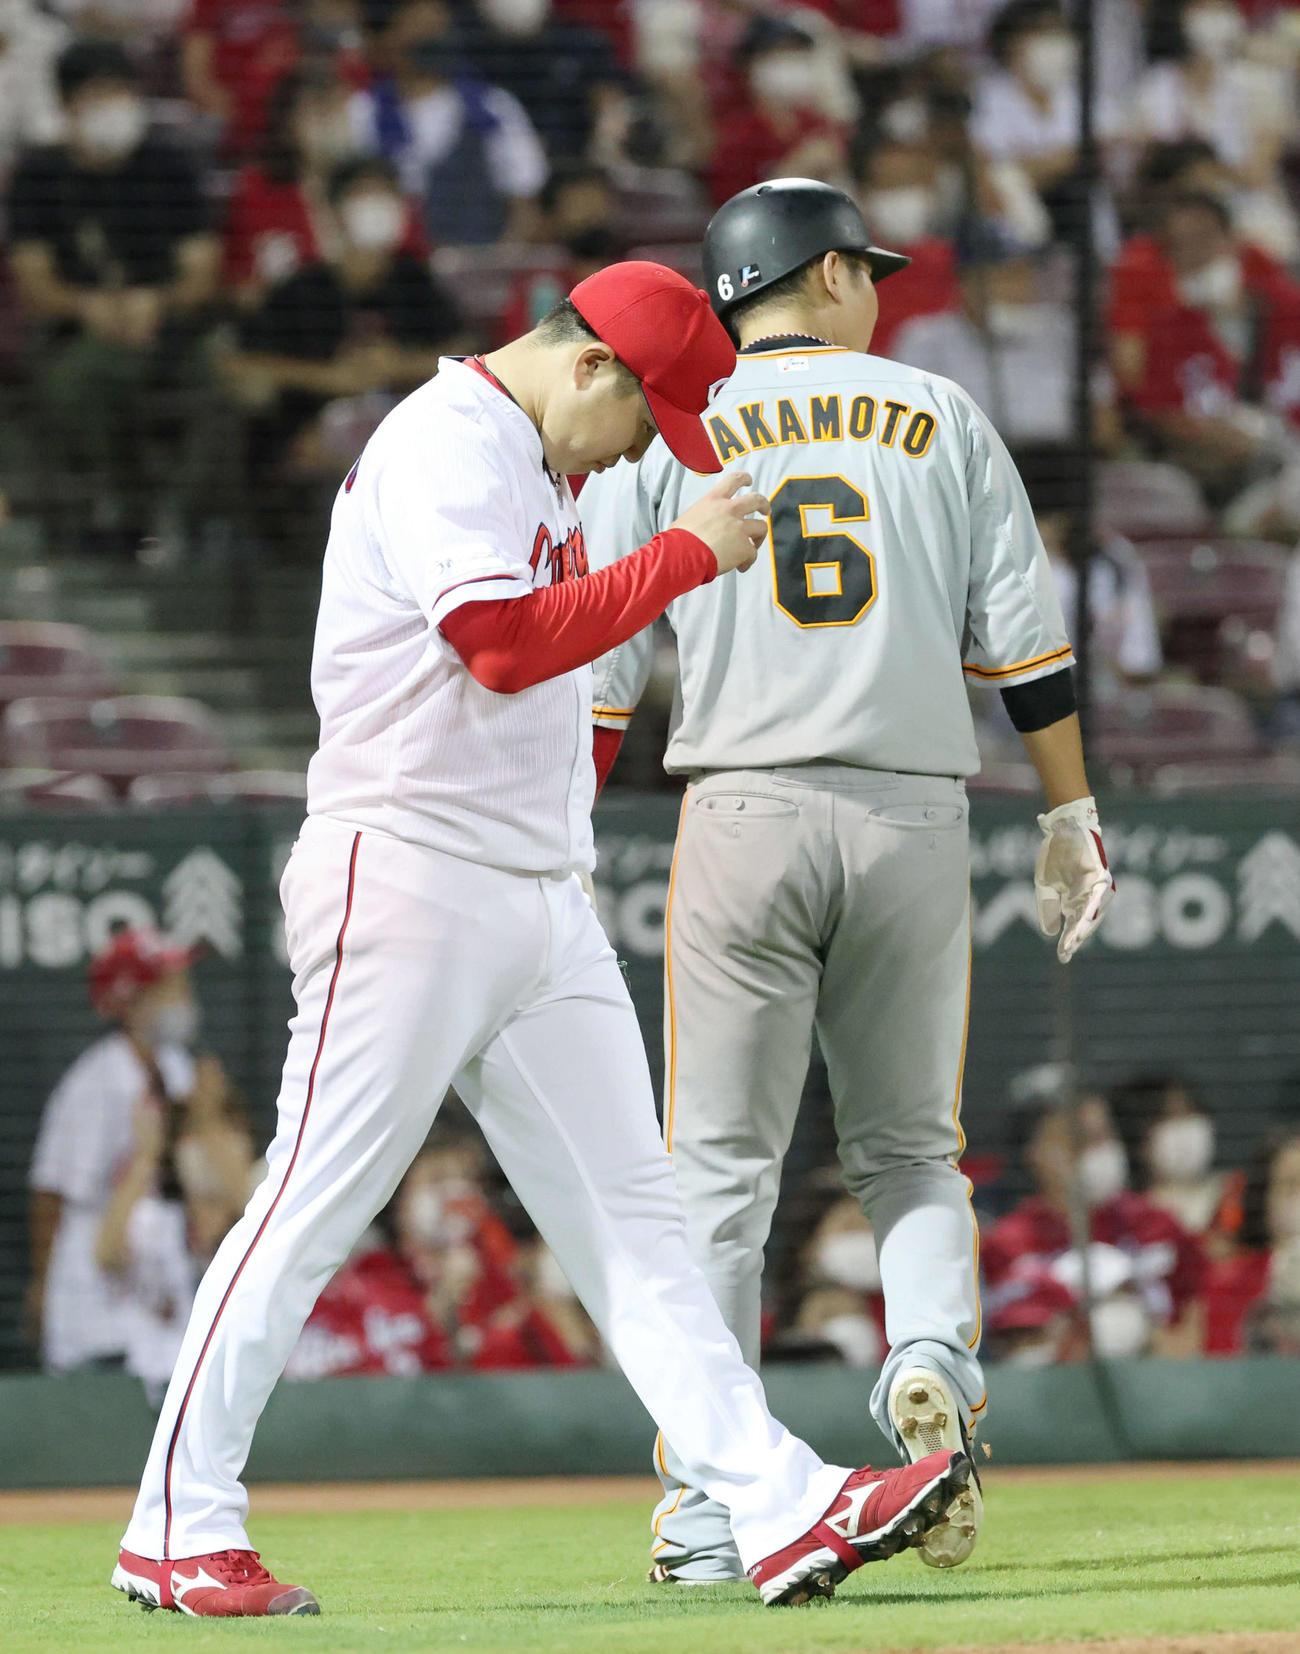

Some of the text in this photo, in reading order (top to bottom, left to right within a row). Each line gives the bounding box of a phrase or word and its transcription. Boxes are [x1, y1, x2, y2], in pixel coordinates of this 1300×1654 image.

[717, 273, 734, 301] 6
[698, 394, 937, 474] AKAMOTO
[767, 473, 878, 629] 6
